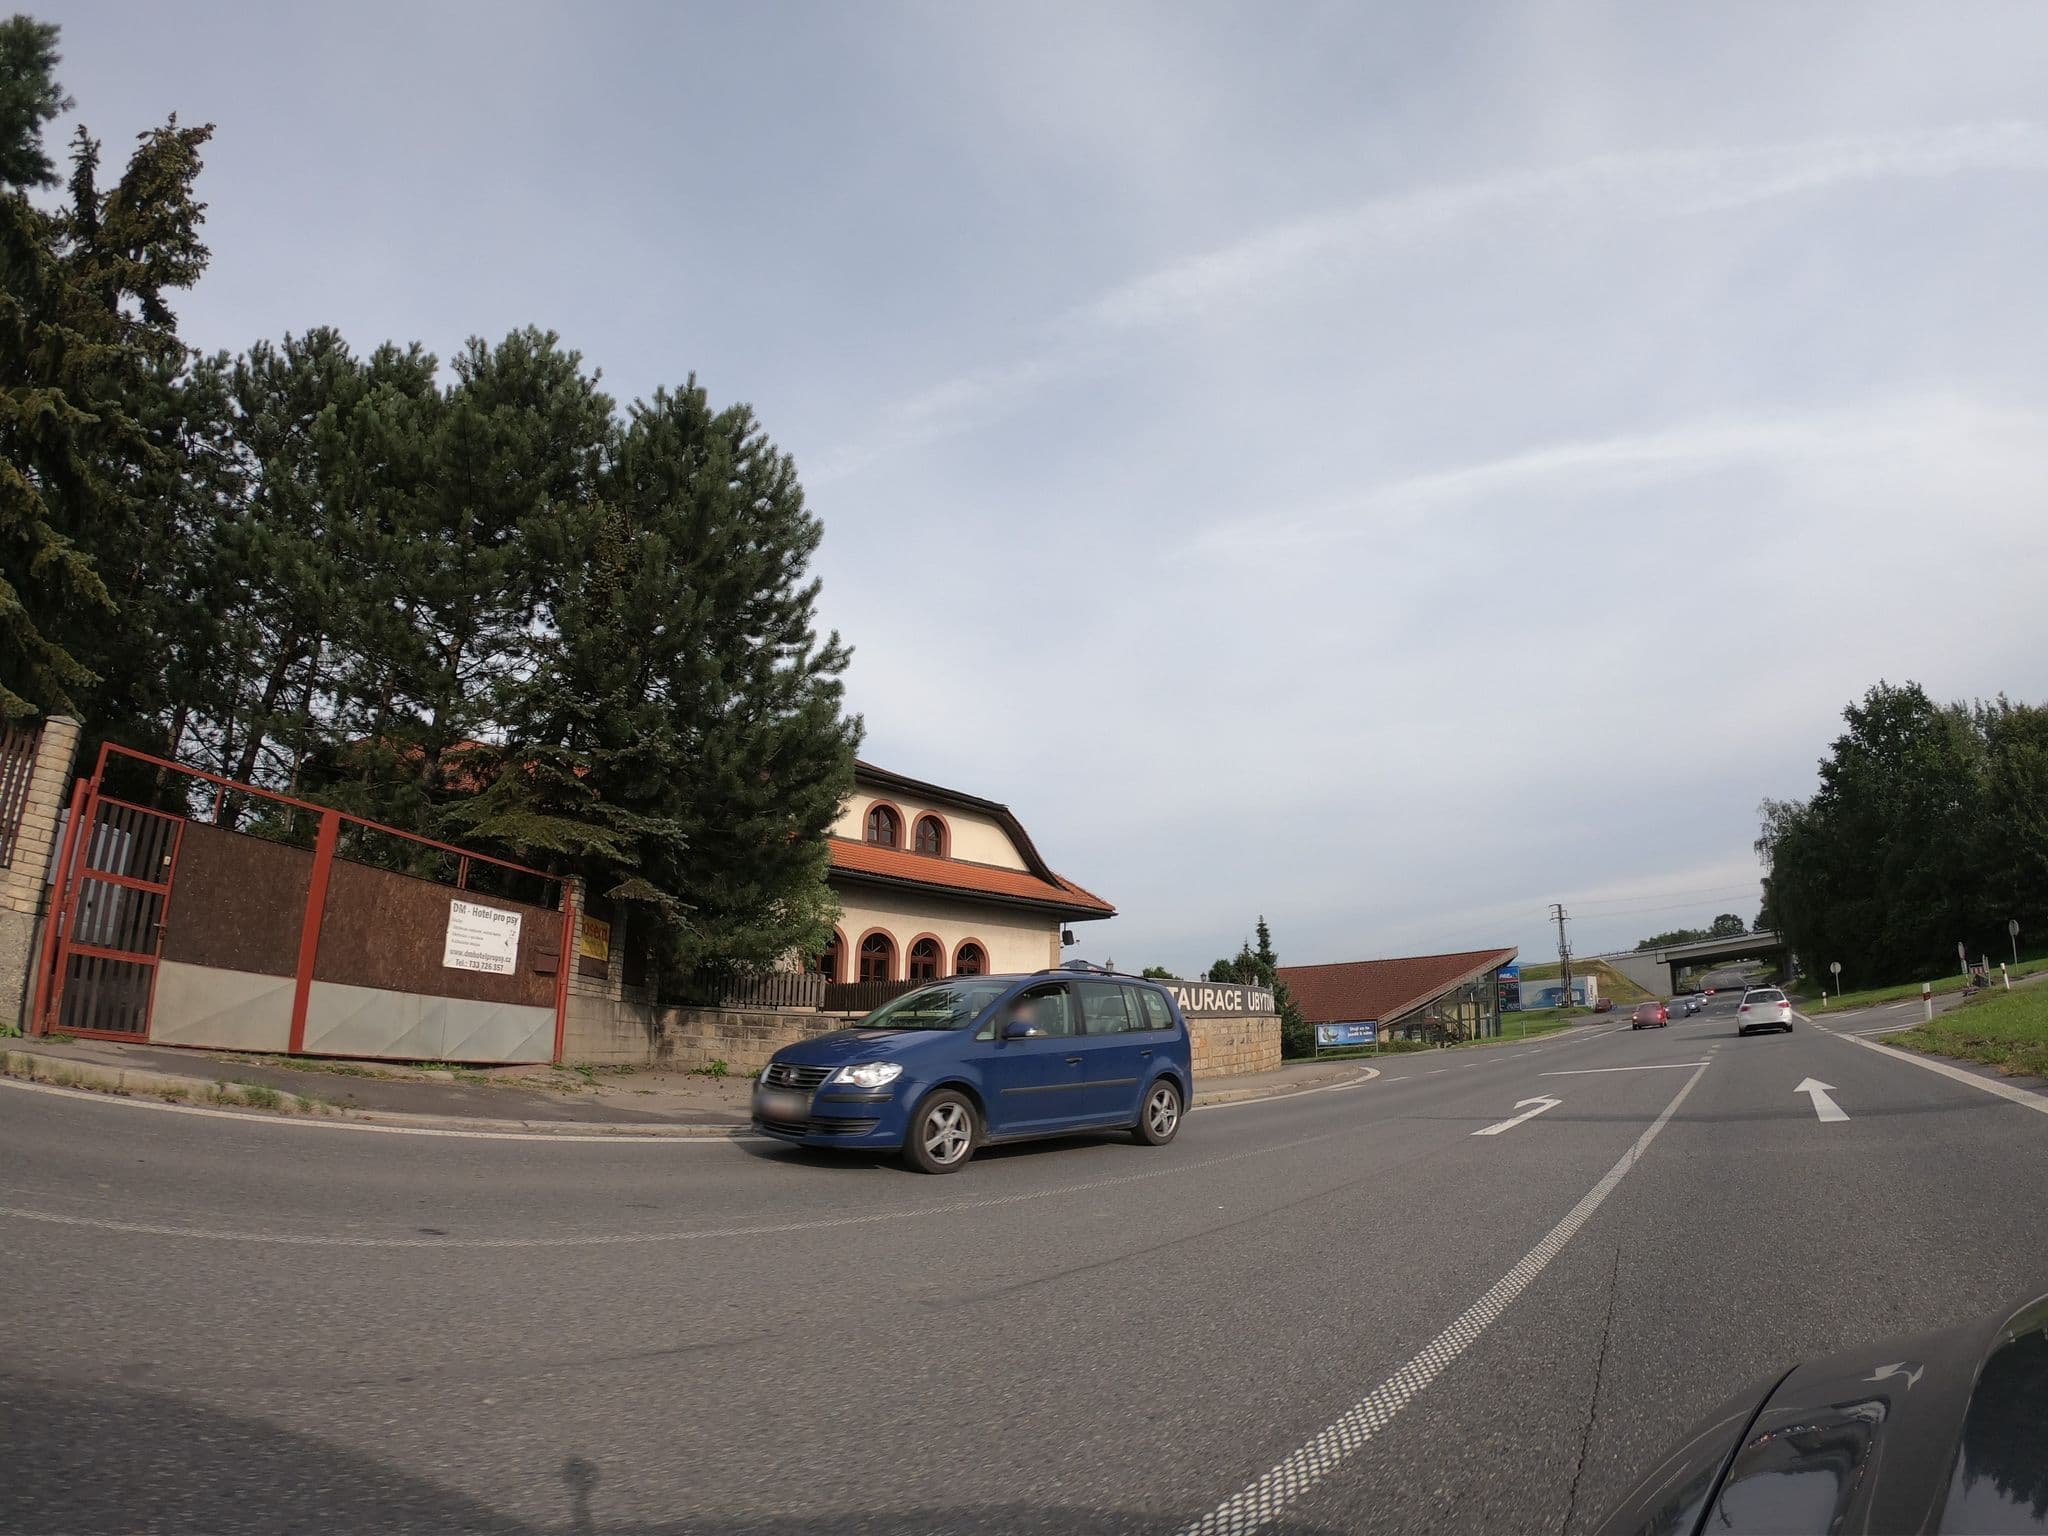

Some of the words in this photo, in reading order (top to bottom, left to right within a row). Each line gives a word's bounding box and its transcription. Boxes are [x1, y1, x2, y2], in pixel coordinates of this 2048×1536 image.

[453, 902, 466, 914] DM
[472, 906, 492, 919] Hotel
[493, 912, 505, 922] pro
[506, 915, 519, 926] psy
